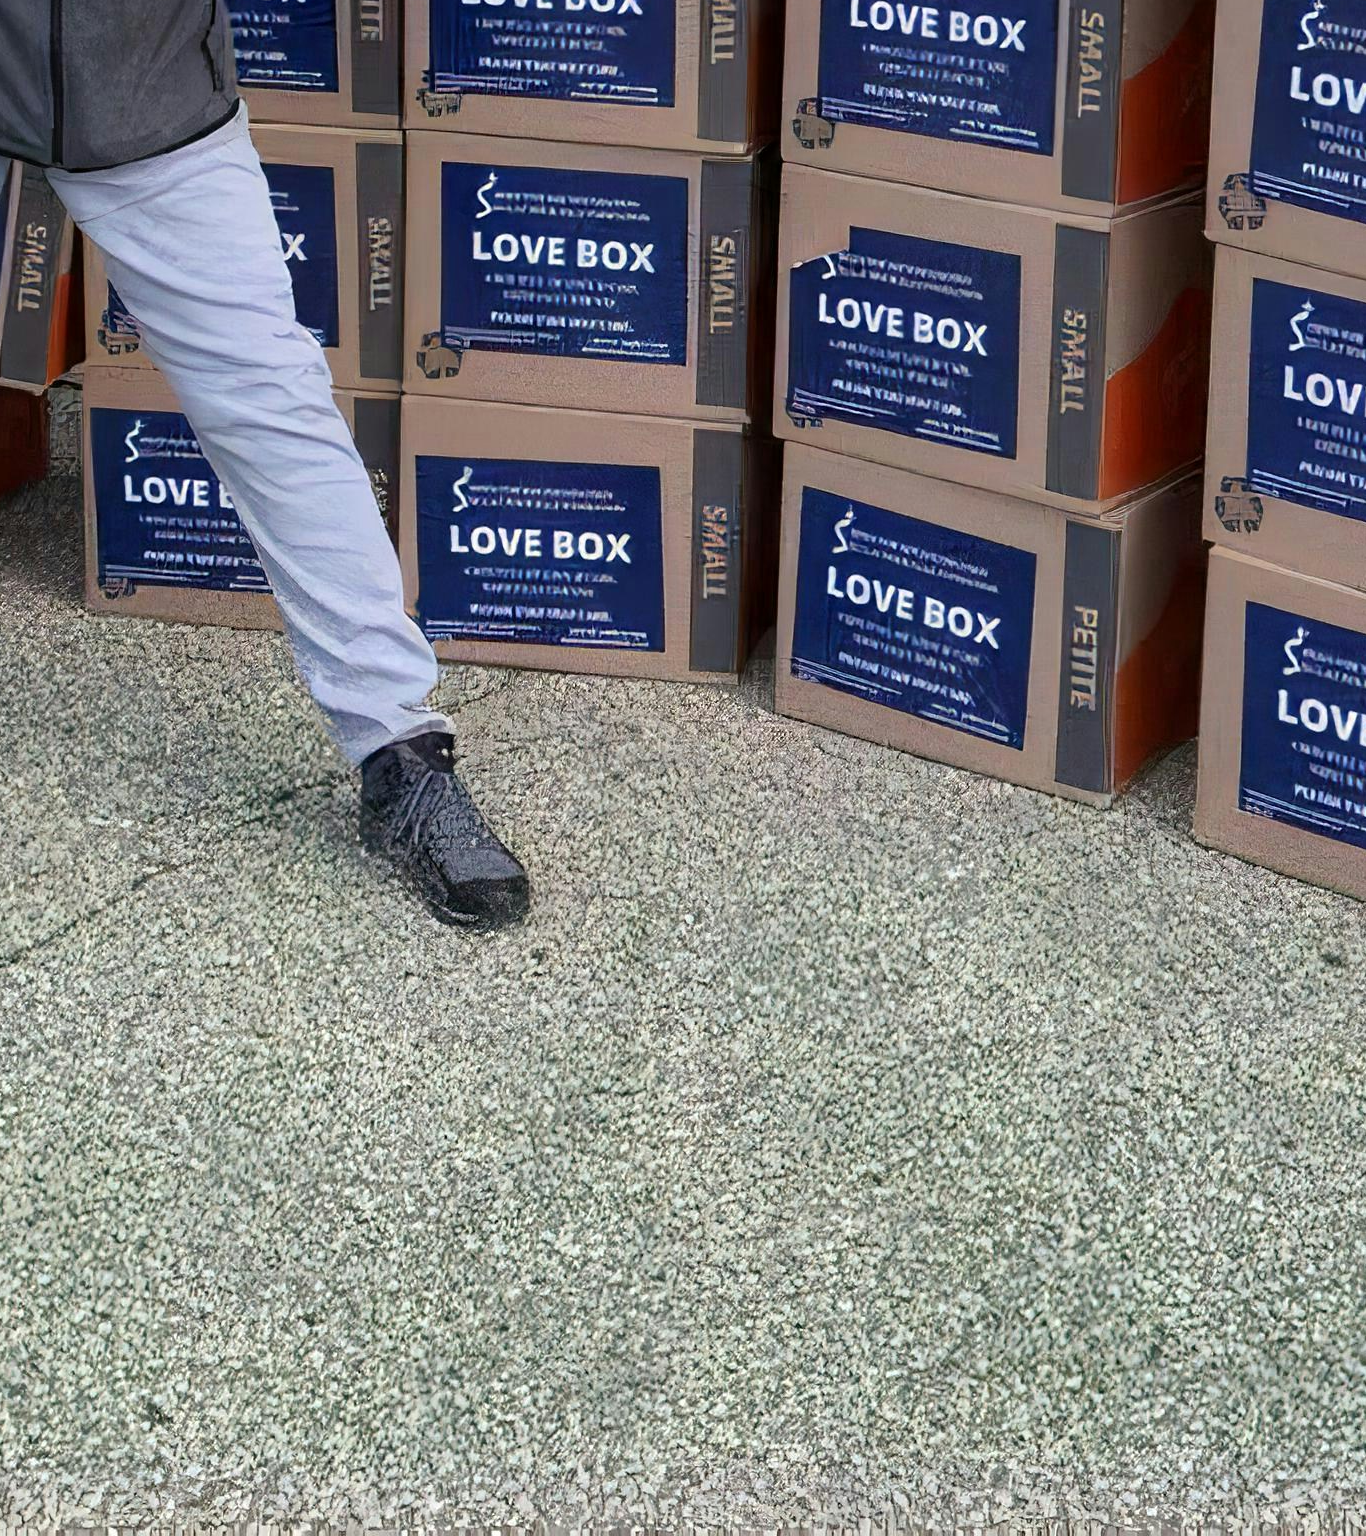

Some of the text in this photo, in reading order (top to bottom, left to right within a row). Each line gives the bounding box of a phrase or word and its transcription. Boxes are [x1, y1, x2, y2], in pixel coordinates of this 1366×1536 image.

[949, 12, 1027, 52] BOX
[1078, 9, 1105, 118] SMALL
[17, 224, 47, 313] SMALL
[367, 217, 393, 311] SMALL
[472, 231, 655, 273] LOVE BOX
[709, 235, 736, 335] SMALL
[818, 293, 989, 357] LOVE BOX
[1060, 308, 1087, 414] SMALL
[123, 475, 208, 508] LOVE
[450, 525, 632, 564] LOVE BOX
[701, 505, 729, 601] SMALL
[827, 566, 1001, 650] LOVE BOX
[1071, 605, 1098, 711] PETITE
